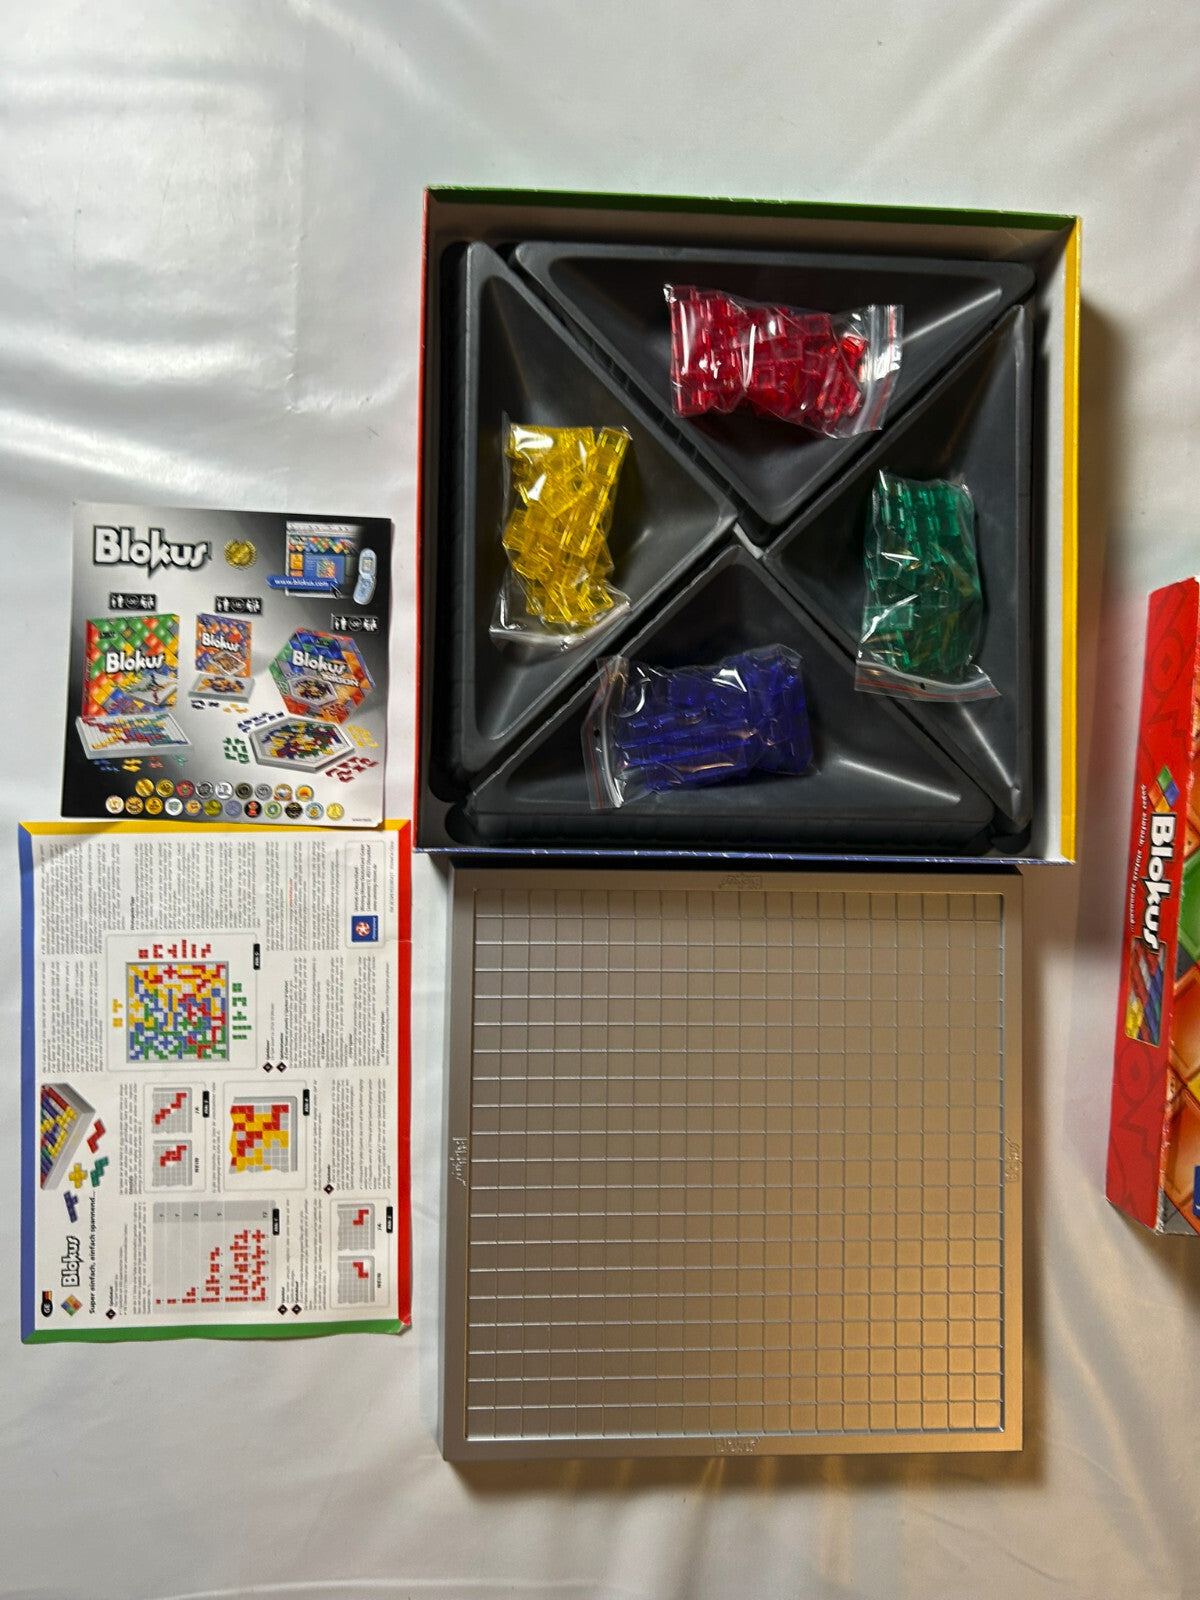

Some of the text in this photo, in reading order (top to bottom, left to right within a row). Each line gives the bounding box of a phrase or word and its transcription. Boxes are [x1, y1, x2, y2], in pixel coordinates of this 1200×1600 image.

[93, 525, 211, 577] Blokus
[201, 632, 240, 652] Blokus
[105, 649, 165, 674] Blokus
[292, 650, 347, 674] Blokus
[1140, 812, 1177, 954] Blokus
[88, 1234, 96, 1260] einfach
[60, 1236, 84, 1287] Blokus
